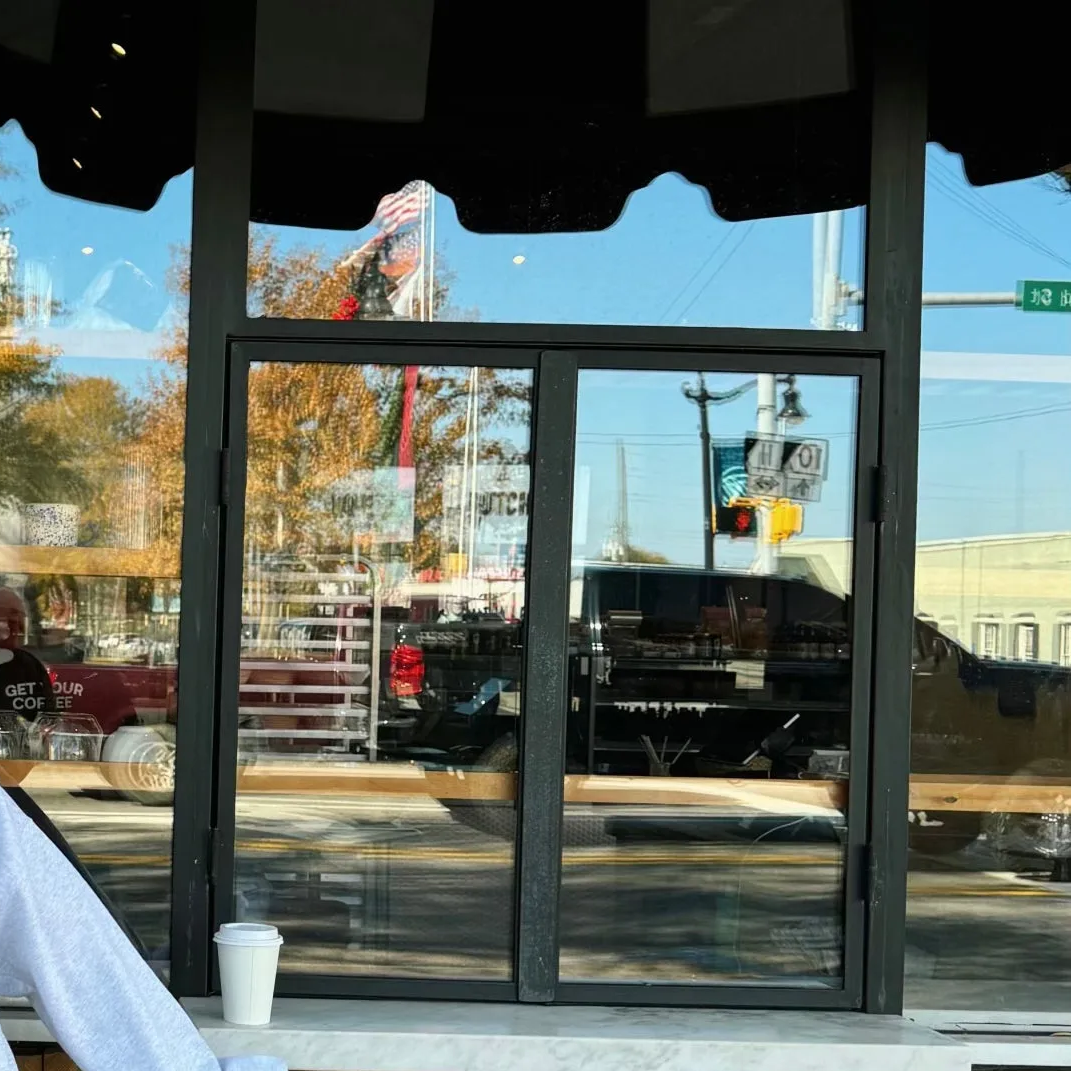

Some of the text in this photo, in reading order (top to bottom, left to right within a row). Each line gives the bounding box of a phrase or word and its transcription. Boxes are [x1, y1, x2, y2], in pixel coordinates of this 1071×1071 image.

[5, 682, 84, 697] GET OUR
[12, 696, 73, 710] COFEE
